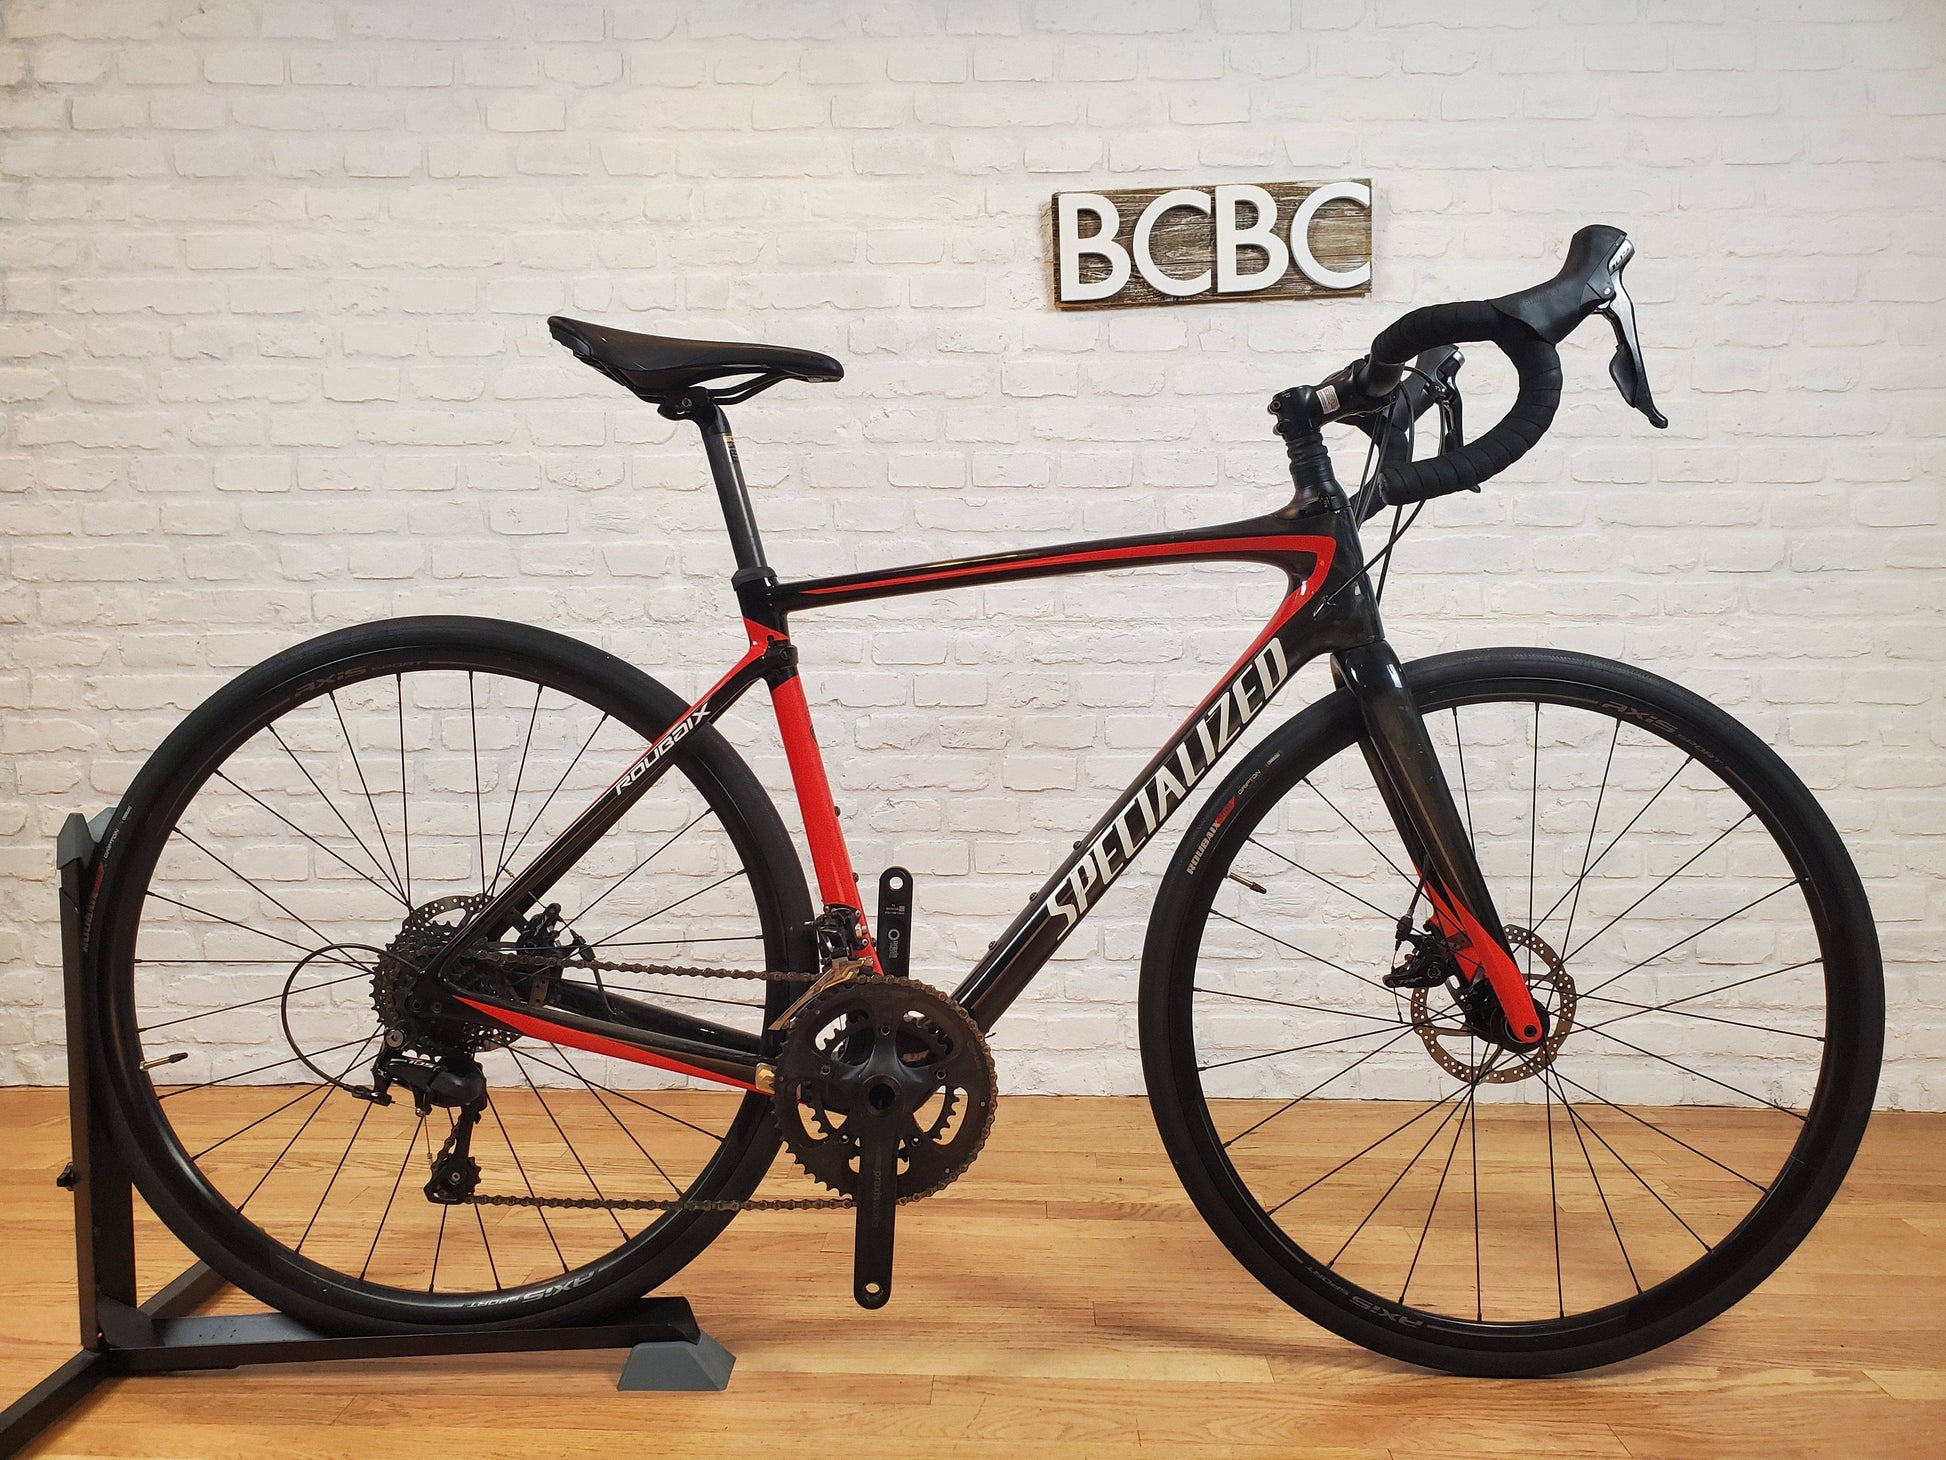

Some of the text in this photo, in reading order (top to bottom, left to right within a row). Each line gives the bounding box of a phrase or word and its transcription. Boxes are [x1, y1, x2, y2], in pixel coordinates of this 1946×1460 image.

[1058, 181, 1370, 301] BCBC
[1046, 637, 1288, 941] SPECIALIZED
[1186, 820, 1222, 876] ROUBAIX
[522, 1271, 595, 1304] AXIS
[1349, 1295, 1423, 1329] AXIS
